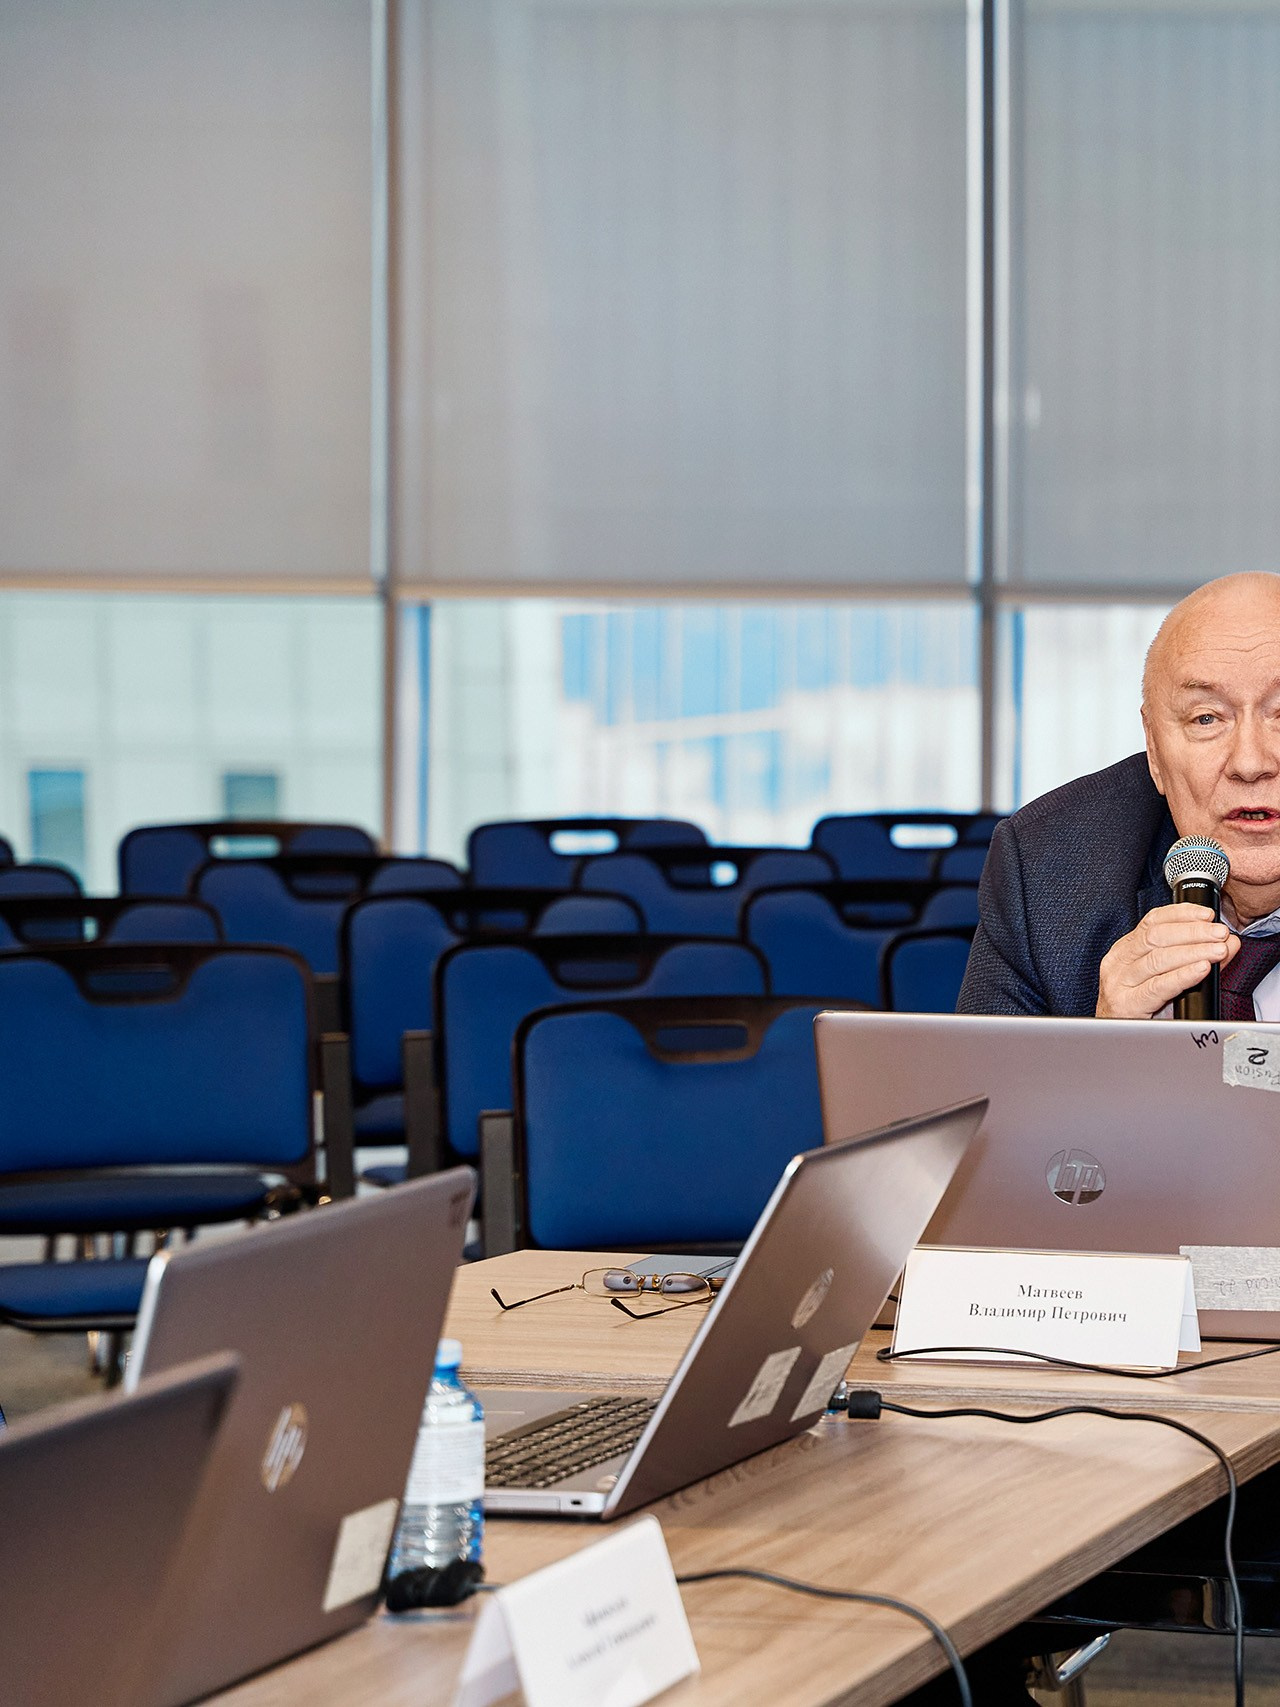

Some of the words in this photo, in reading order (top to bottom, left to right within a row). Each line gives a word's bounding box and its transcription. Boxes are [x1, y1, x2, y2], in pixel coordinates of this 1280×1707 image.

[1246, 1047, 1270, 1066] 2
[1052, 1148, 1102, 1206] hp
[1017, 1284, 1083, 1299] Матвеев
[968, 1303, 1046, 1322] Владимир
[1051, 1306, 1127, 1324] Петрович
